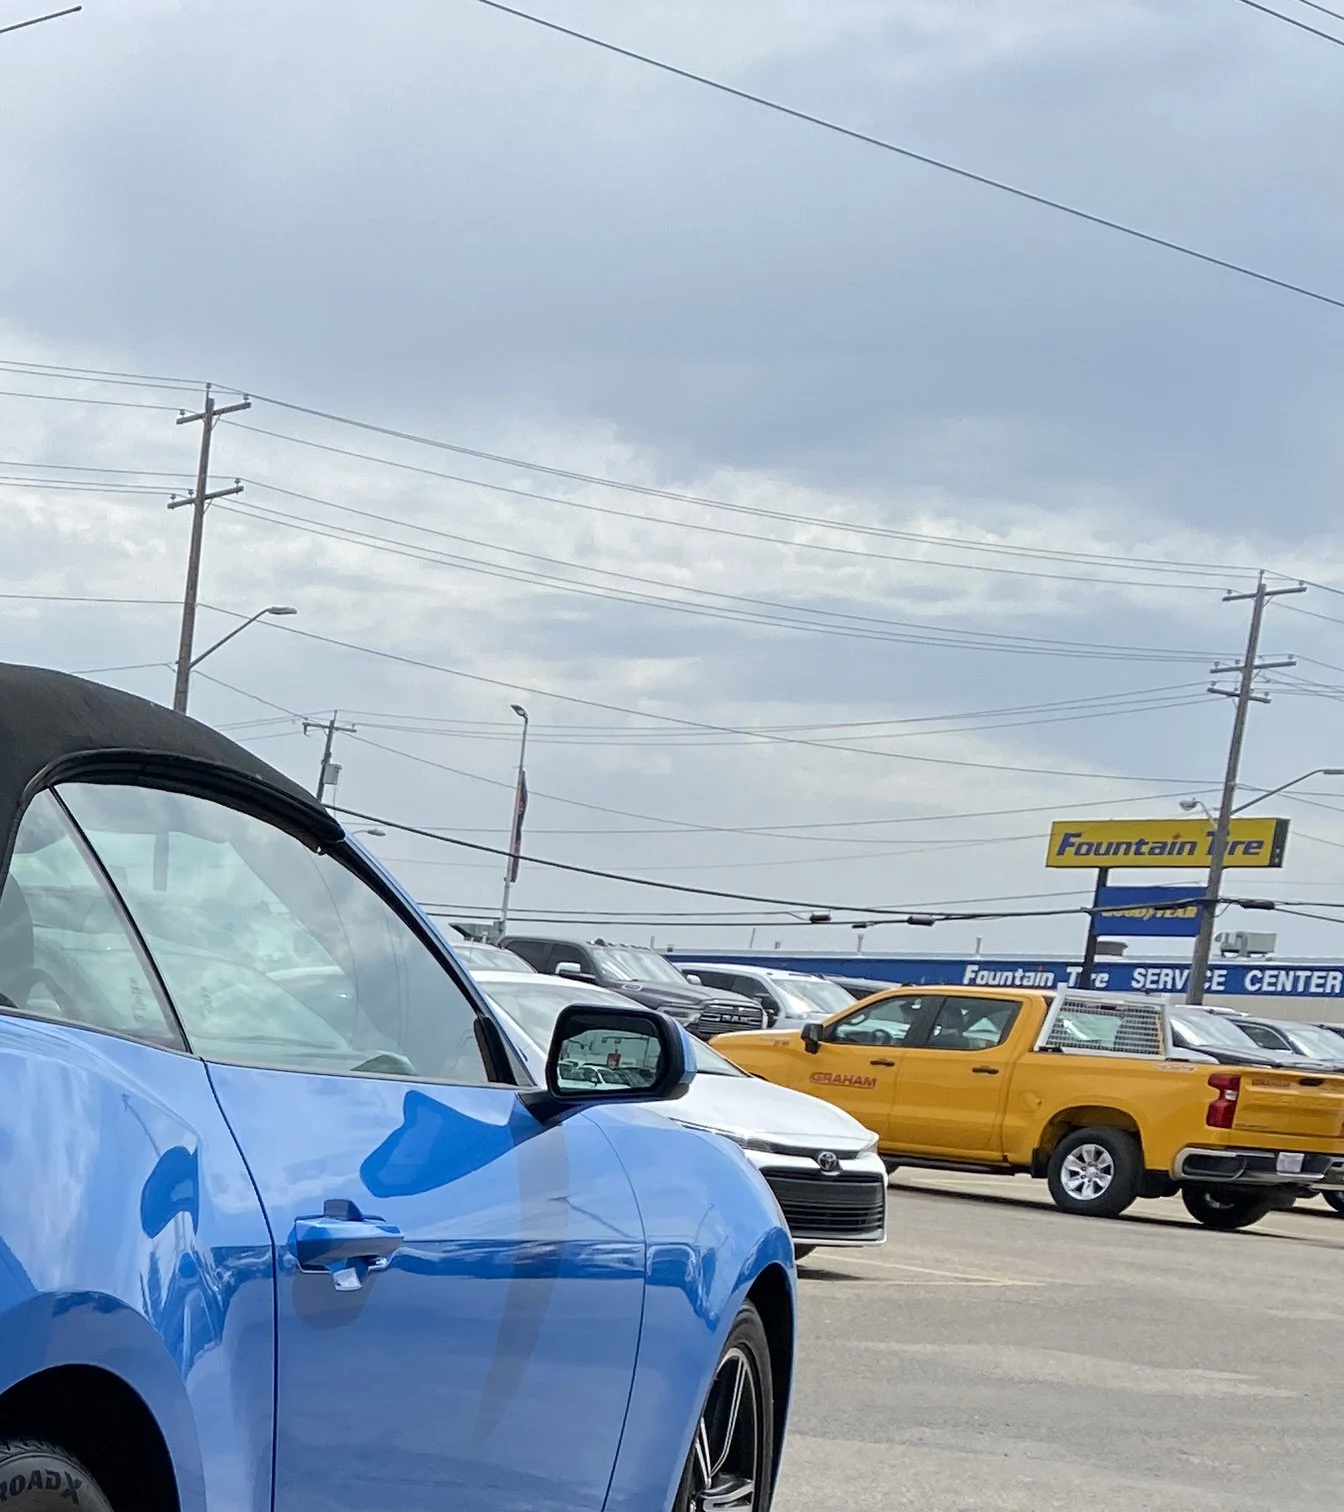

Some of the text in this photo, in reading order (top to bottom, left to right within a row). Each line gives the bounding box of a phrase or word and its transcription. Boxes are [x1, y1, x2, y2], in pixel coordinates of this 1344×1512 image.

[1056, 830, 1265, 857] Fountain Tre
[963, 964, 1344, 993] Fountain Tre SERVCE CENTER
[810, 1071, 877, 1089] GRAHAM
